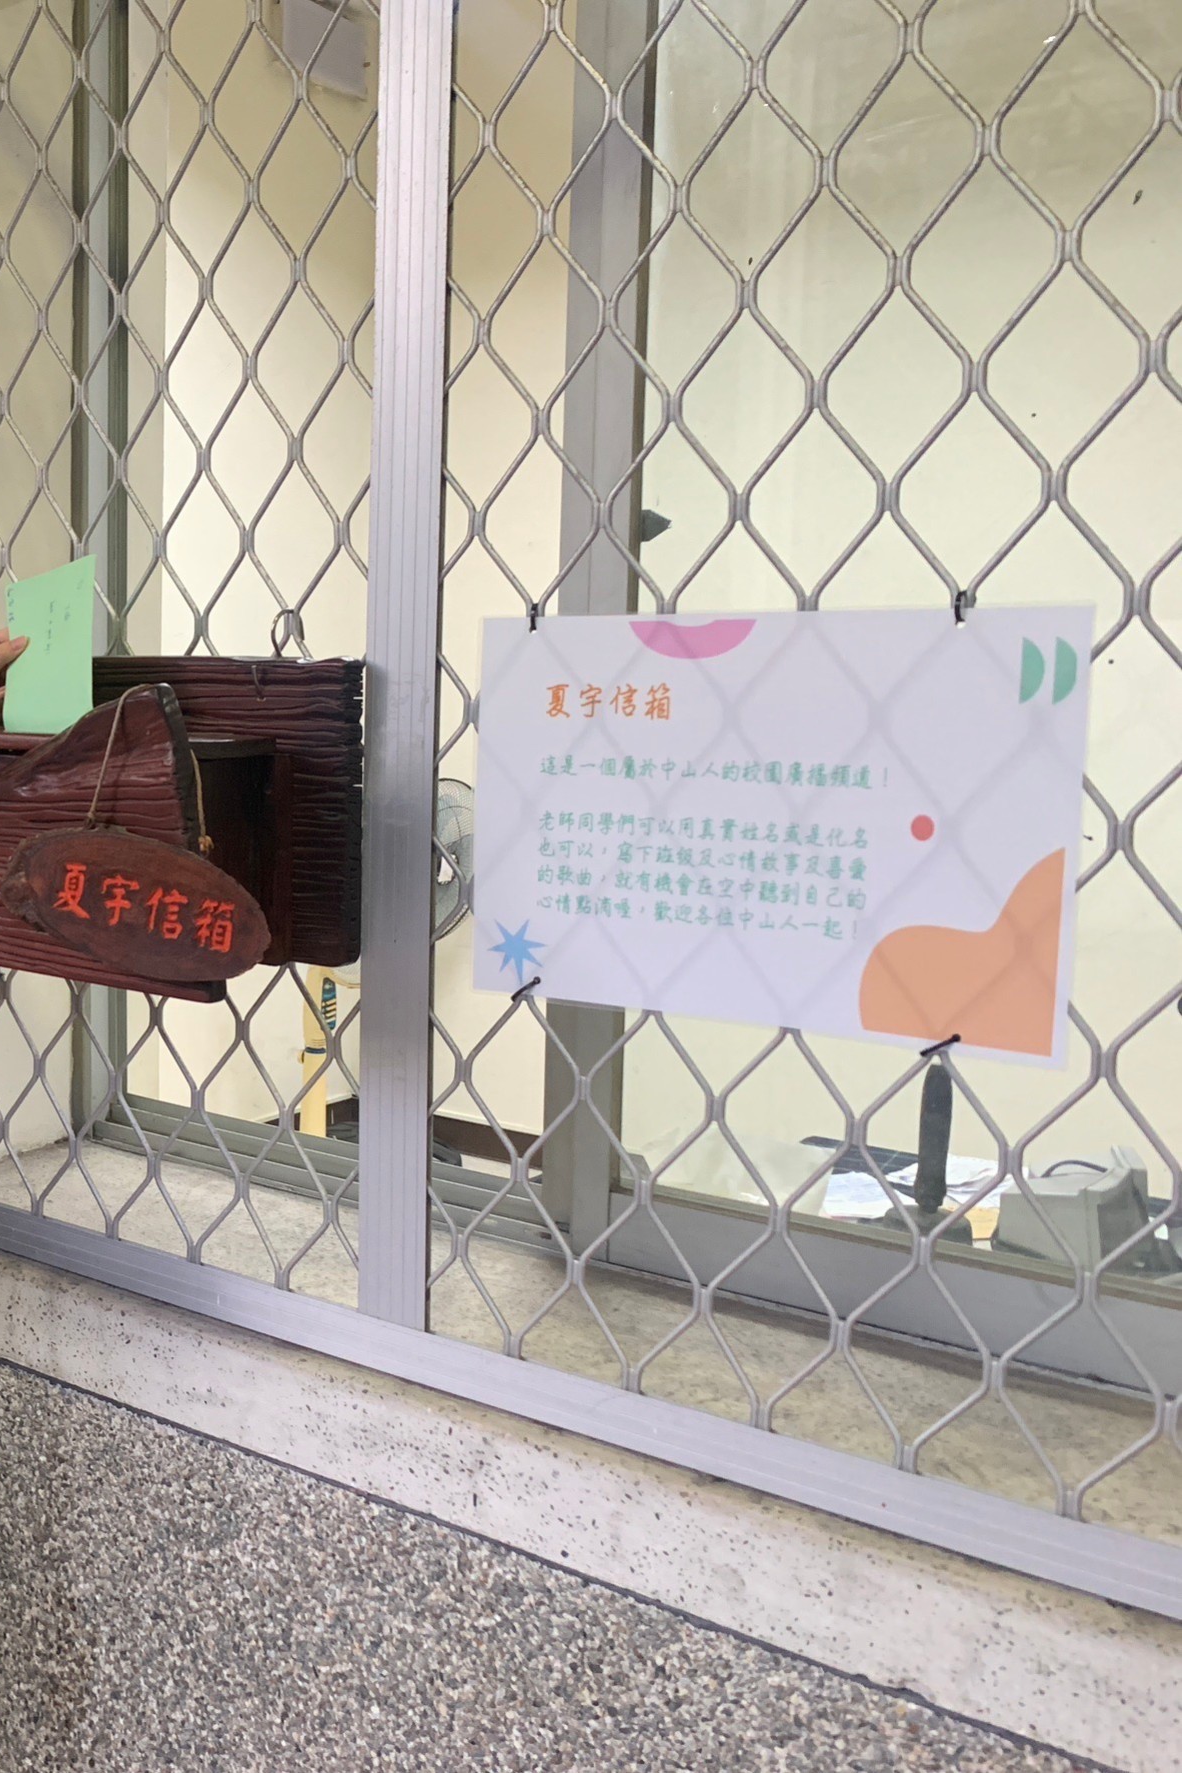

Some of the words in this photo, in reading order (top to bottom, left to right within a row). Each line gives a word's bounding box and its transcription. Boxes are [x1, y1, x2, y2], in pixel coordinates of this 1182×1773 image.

[545, 682, 671, 721] 夏宇信箱
[53, 863, 236, 953] 夏宇信箱
